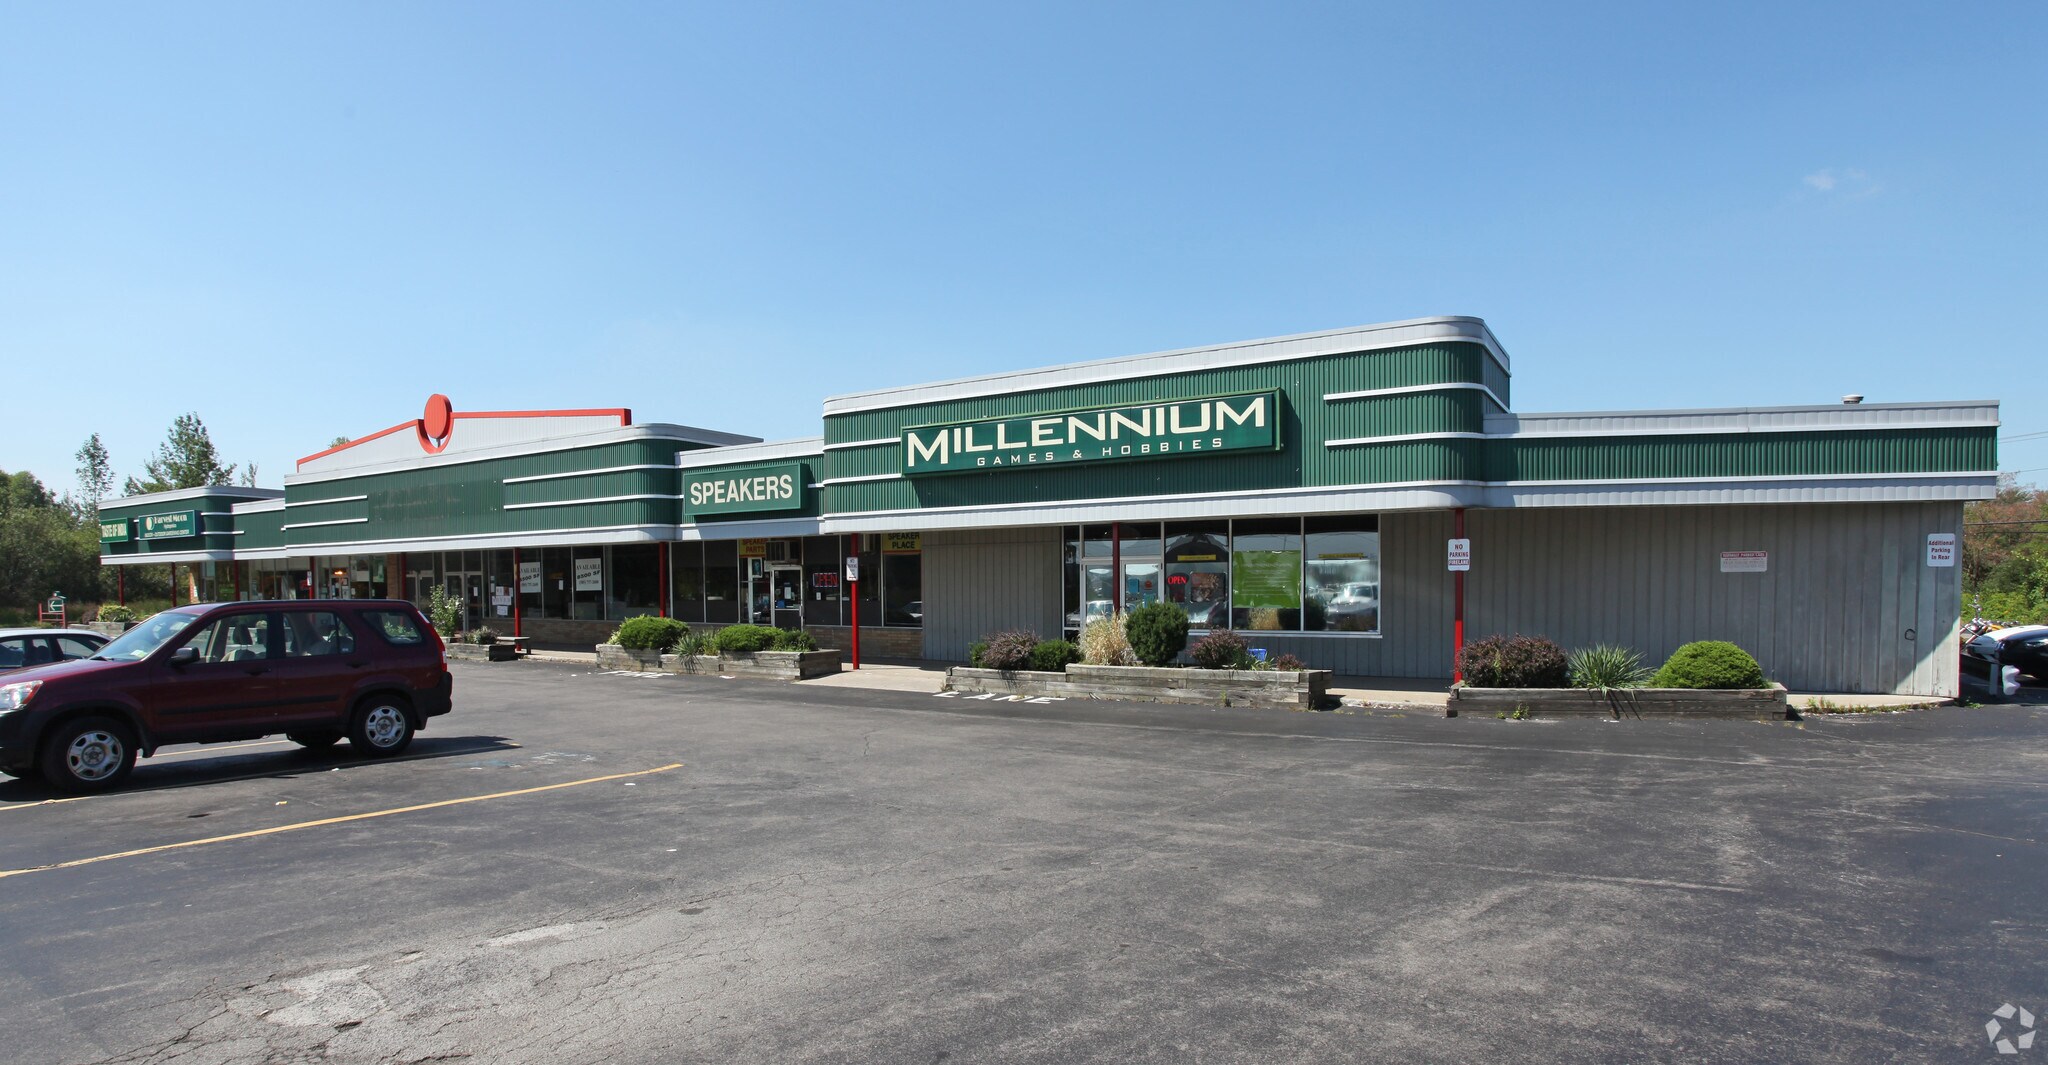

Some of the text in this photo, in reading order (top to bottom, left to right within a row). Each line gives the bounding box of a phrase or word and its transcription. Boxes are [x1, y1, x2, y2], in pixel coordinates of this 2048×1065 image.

[907, 397, 1265, 467] MILLENNIUM
[977, 437, 1223, 466] GAMES & HOBBIES
[690, 474, 793, 505] SPEAKERS
[888, 532, 919, 540] SPEAKER
[892, 541, 915, 549] PLACE
[1167, 575, 1187, 585] OPEN
